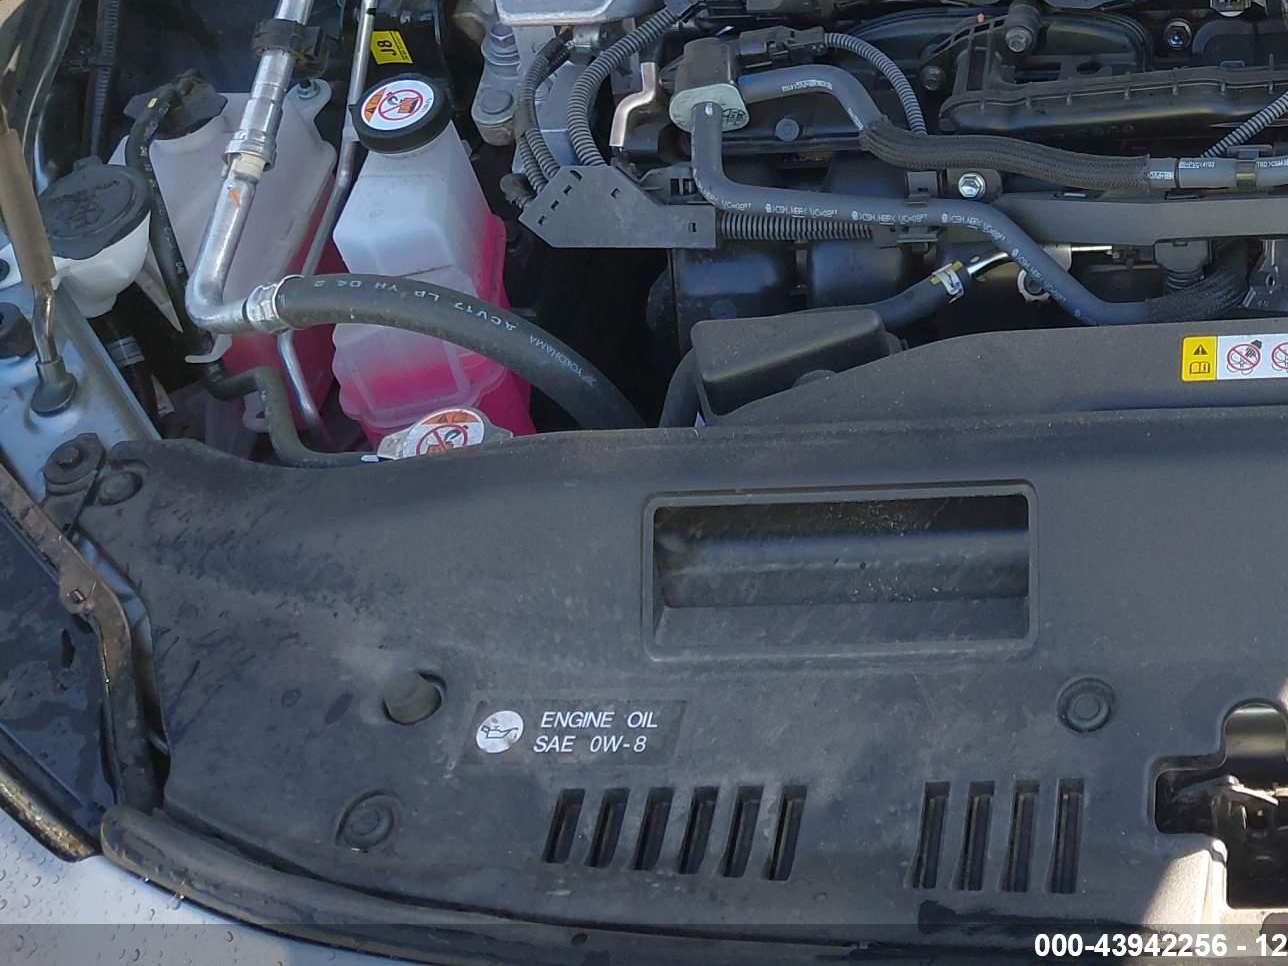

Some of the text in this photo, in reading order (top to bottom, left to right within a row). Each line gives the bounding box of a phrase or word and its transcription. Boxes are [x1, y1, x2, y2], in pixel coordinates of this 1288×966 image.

[377, 39, 397, 56] J8
[540, 711, 658, 728] ENGINE OIL
[533, 735, 647, 753] SAE 0W-8
